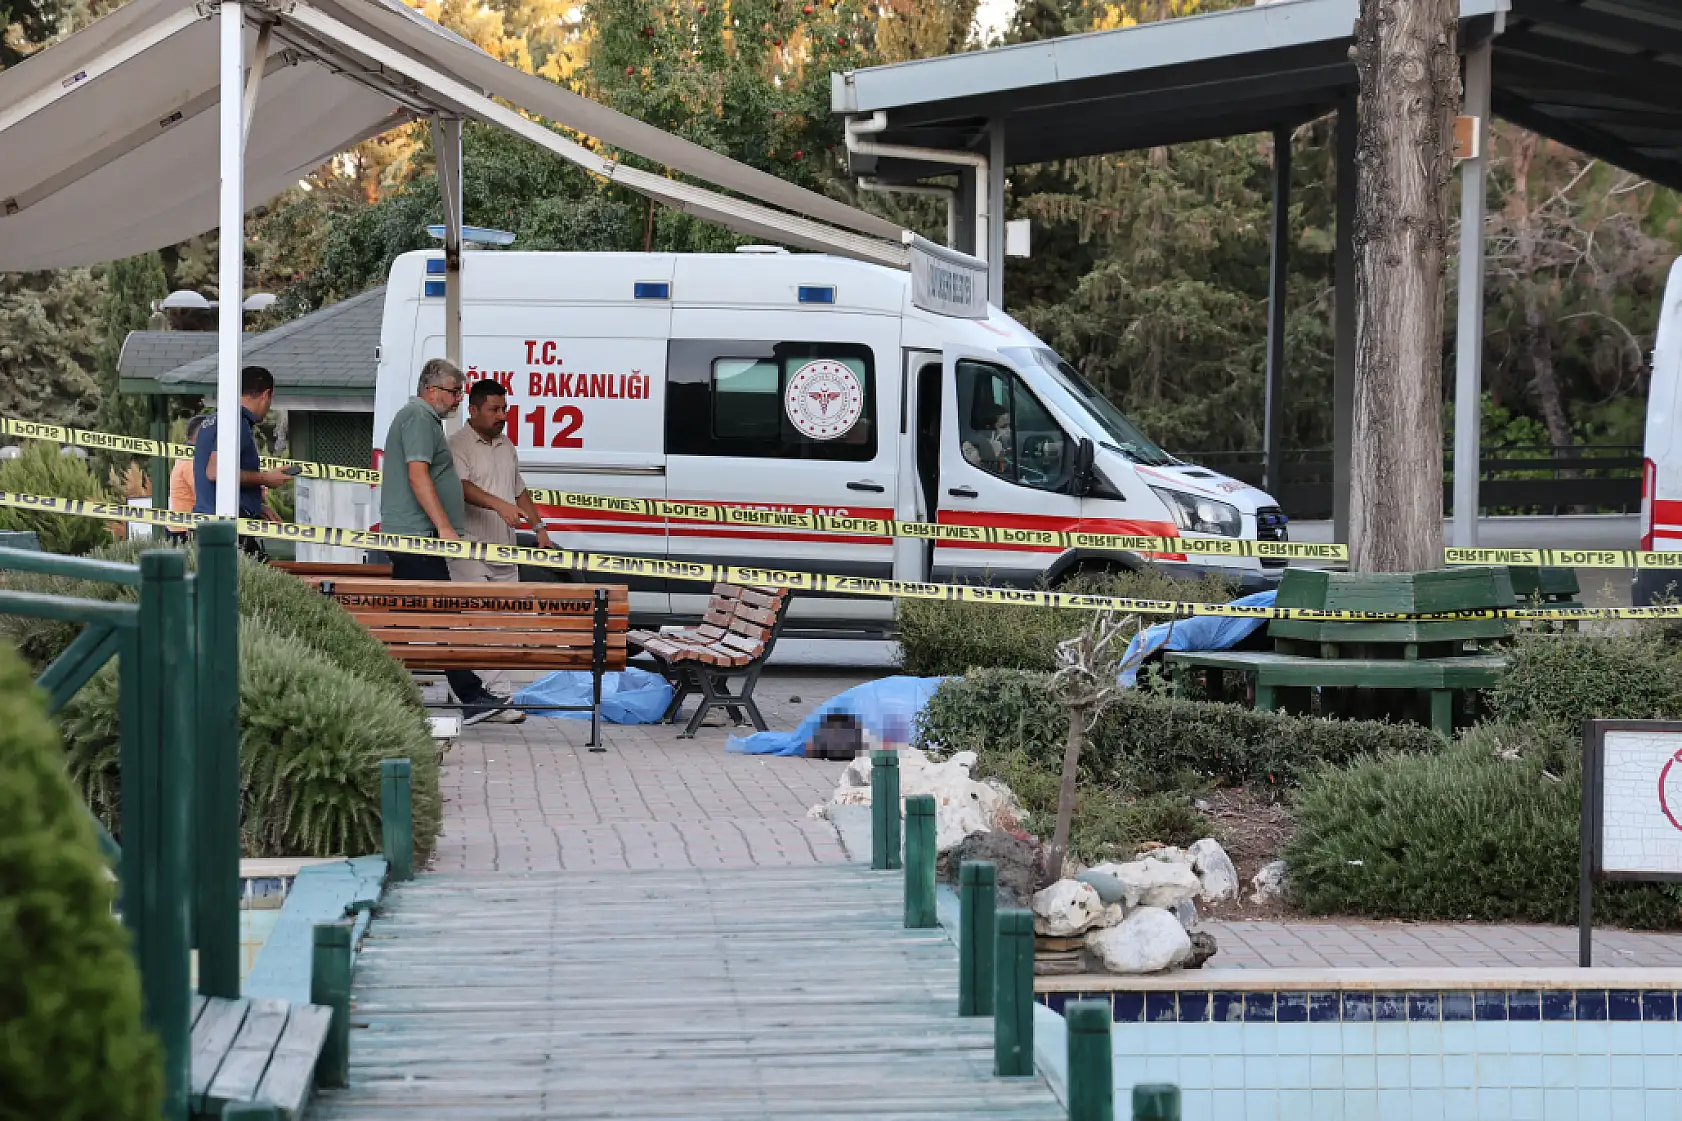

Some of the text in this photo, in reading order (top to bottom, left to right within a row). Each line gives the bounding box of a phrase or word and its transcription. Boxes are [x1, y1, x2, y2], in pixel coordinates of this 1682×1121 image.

[524, 340, 563, 365] T.C.
[527, 369, 650, 400] BAKANLIĞI
[506, 404, 584, 449] 112
[246, 520, 317, 539] POLİS
[496, 545, 564, 565] POLİS
